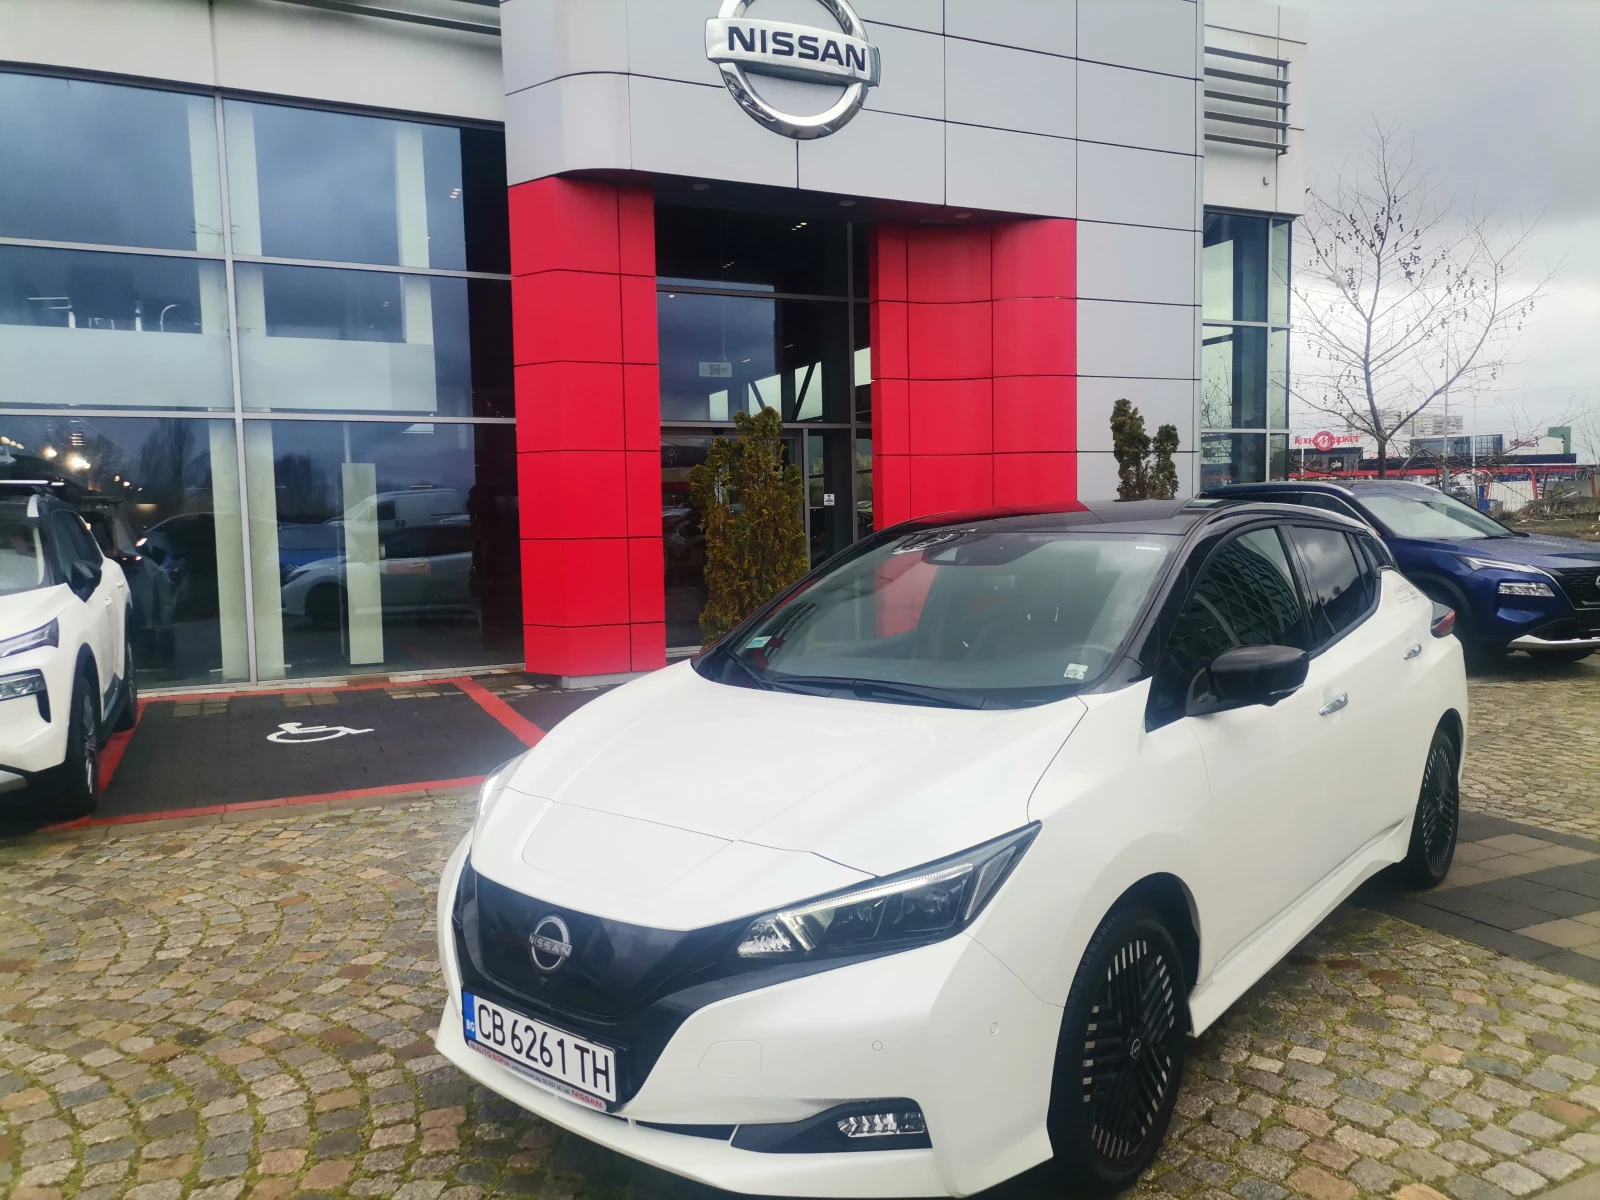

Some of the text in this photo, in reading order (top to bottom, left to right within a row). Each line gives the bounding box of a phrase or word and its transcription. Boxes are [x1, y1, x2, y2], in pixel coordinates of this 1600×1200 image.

[727, 26, 867, 72] NISSAN
[529, 934, 571, 957] NISSAN
[466, 1019, 475, 1032] BG
[478, 1004, 506, 1046] CB
[511, 1019, 567, 1075] 6261
[574, 1043, 610, 1094] TH
[571, 1088, 602, 1108] NISSAN
